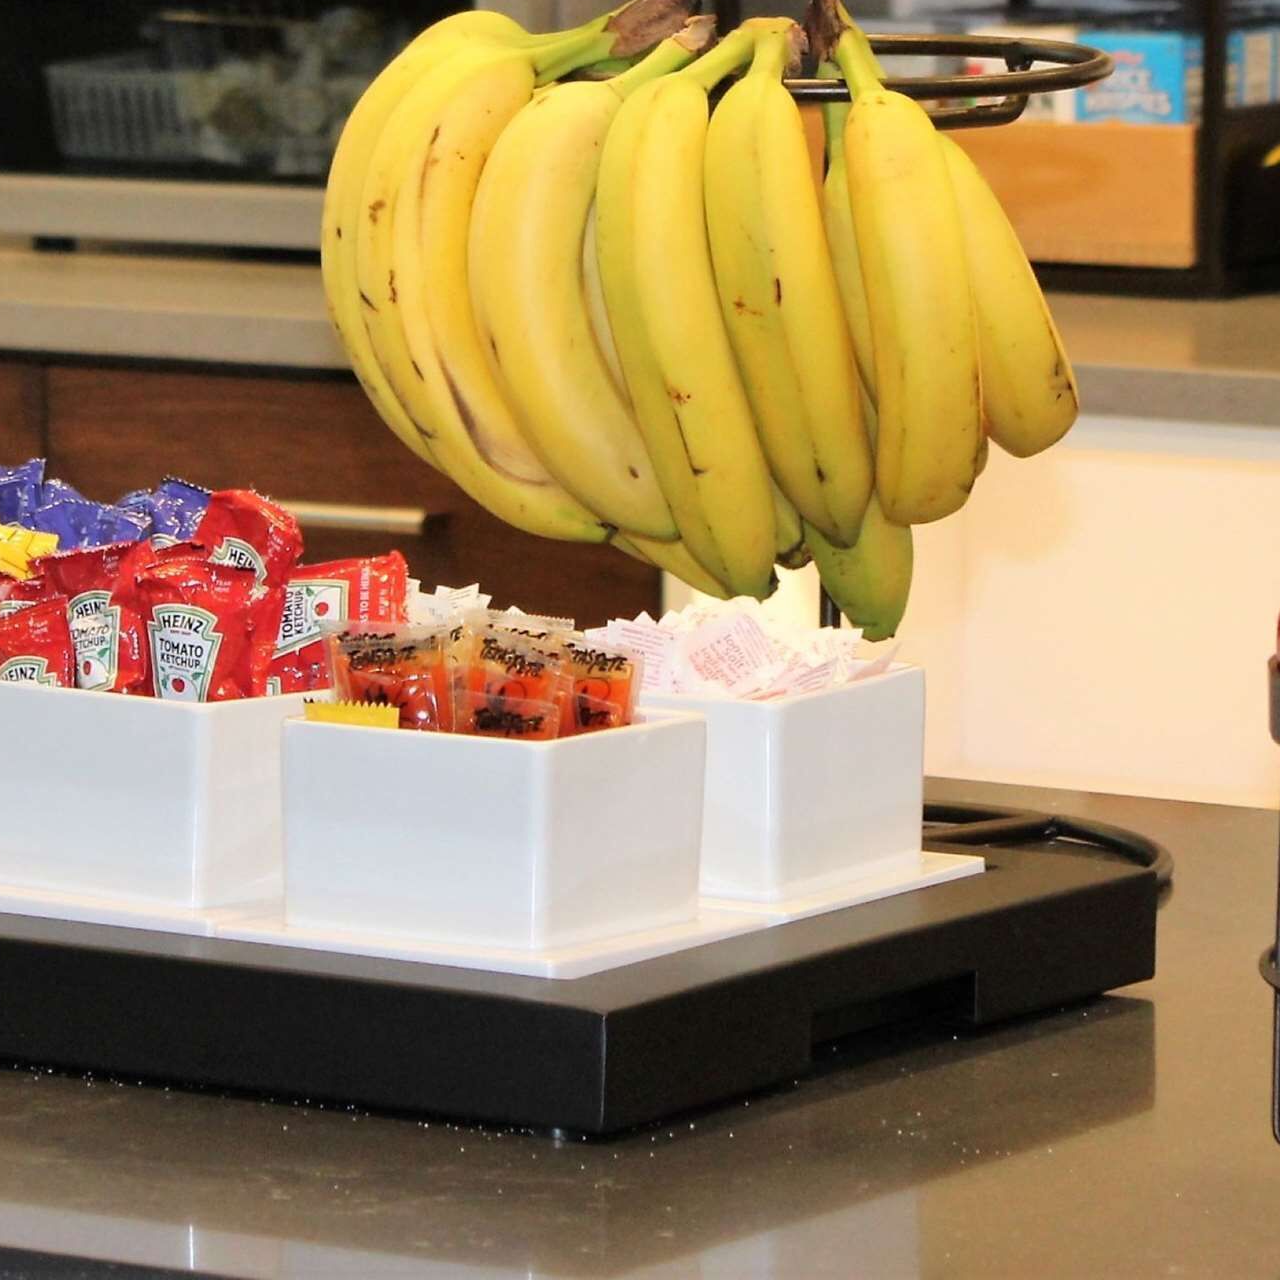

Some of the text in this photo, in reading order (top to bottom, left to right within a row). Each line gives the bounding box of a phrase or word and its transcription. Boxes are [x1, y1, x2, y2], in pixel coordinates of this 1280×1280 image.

[282, 591, 295, 641] TOMATO
[294, 591, 304, 635] KETCHUP
[71, 624, 110, 640] OMATO
[161, 615, 204, 634] HEINZ
[73, 635, 106, 650] ETCHUP
[159, 637, 204, 658] TOMATO
[160, 653, 201, 669] KETCHUP
